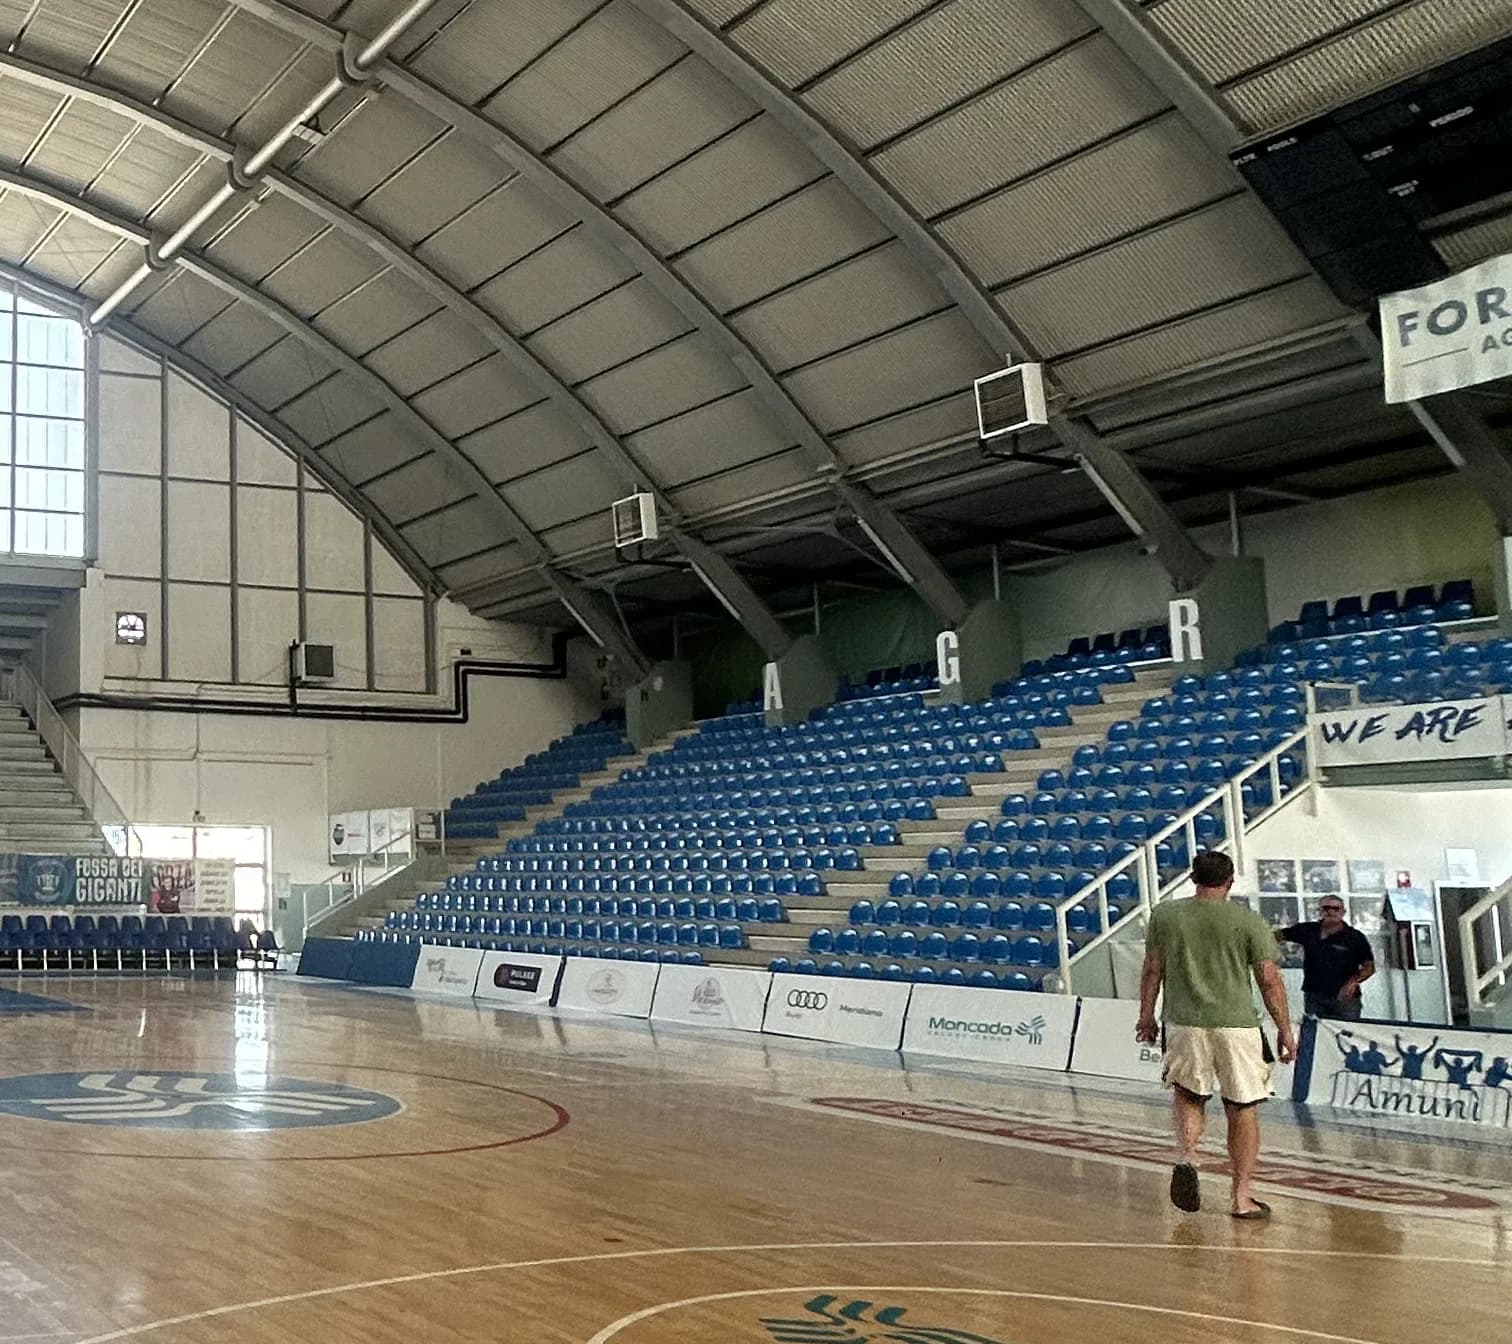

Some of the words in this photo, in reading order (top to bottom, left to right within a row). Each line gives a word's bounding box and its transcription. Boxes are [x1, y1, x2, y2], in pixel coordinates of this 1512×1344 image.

[764, 662, 783, 711] A
[936, 631, 960, 685] G
[1169, 599, 1203, 662] R
[1321, 713, 1390, 743] WE
[1395, 704, 1486, 743] ARE
[76, 857, 118, 877] FOSSA
[122, 857, 143, 877] DEI
[75, 877, 143, 902] GIGANTI
[929, 1016, 1013, 1036] Moncada
[1140, 1048, 1164, 1063] Be
